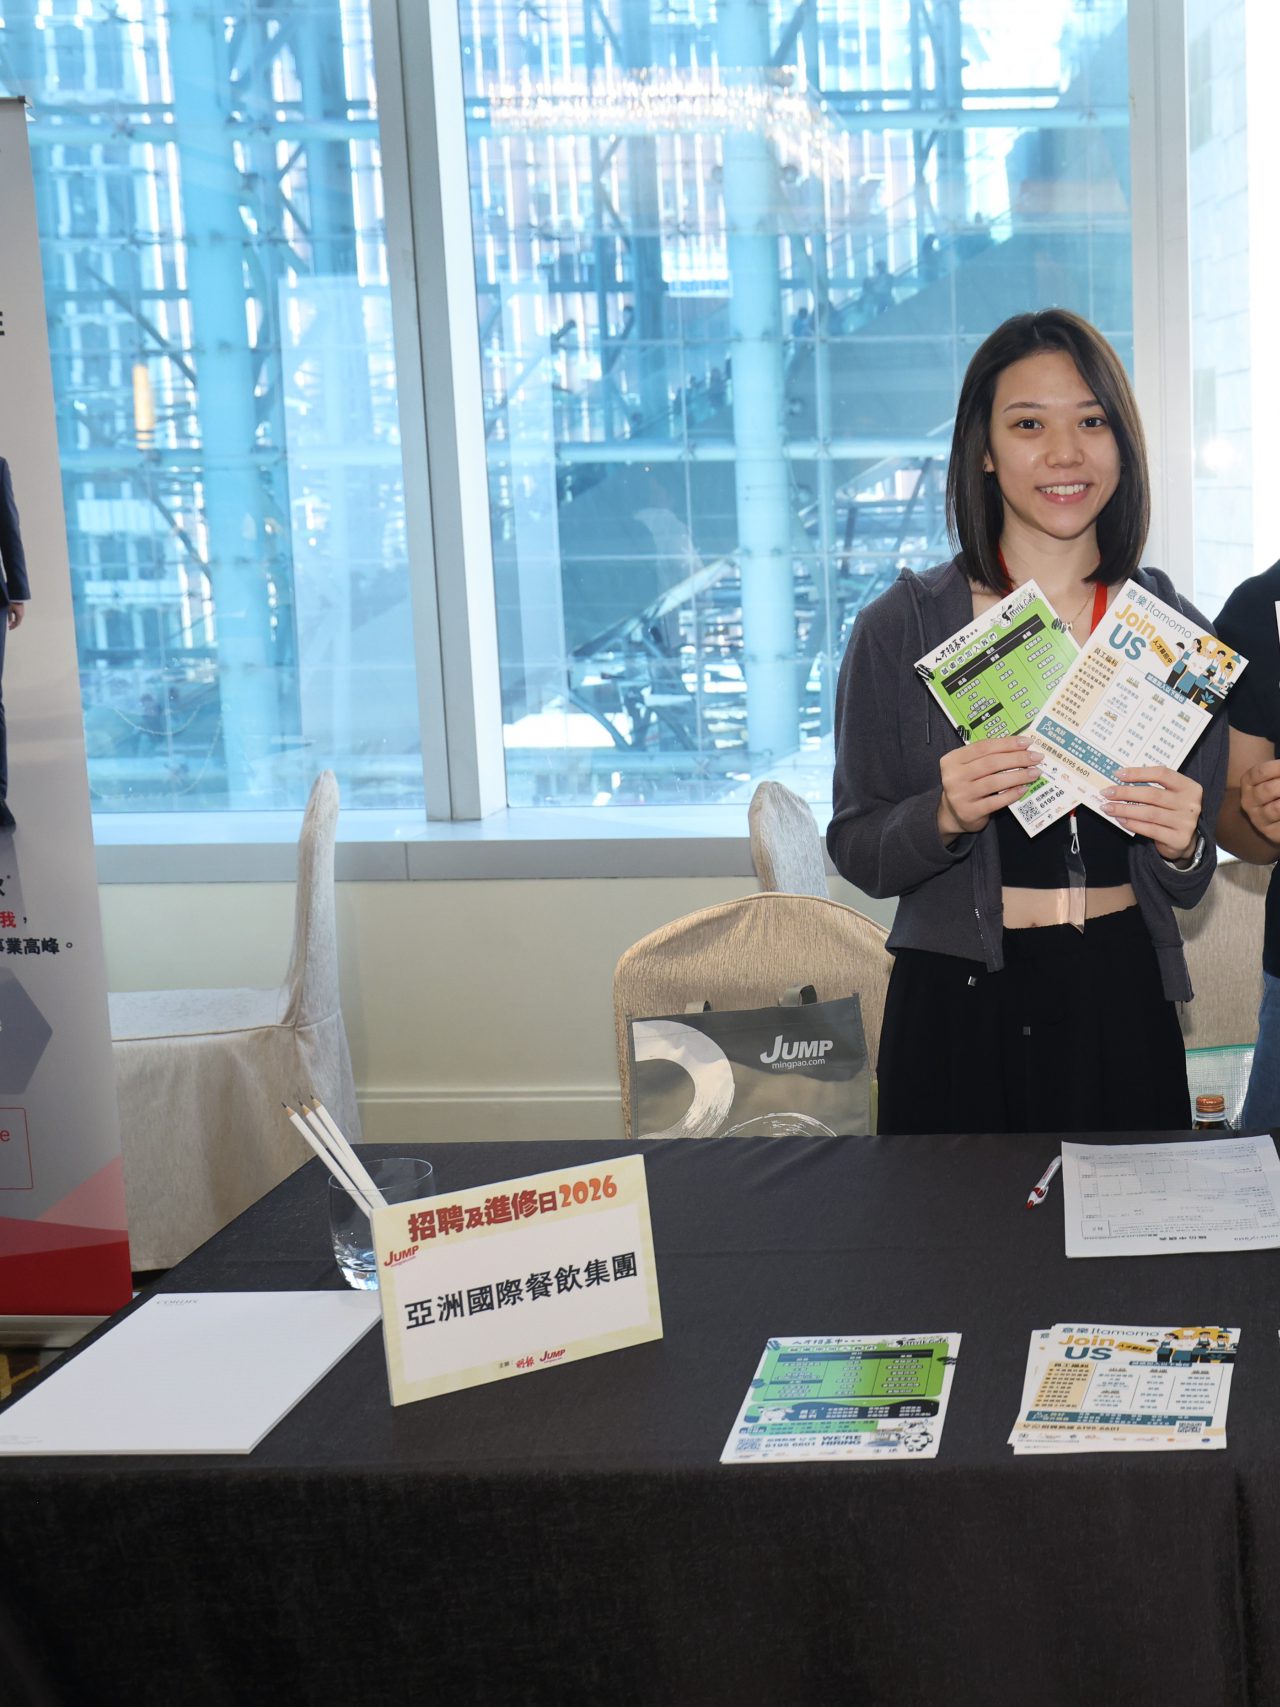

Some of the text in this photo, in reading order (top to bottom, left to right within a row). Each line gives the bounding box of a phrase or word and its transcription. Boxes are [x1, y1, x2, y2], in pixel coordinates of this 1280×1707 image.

[1115, 604, 1156, 639] Join
[1145, 601, 1192, 639] Itamomo
[1109, 624, 1146, 660] US
[1062, 756, 1076, 769] 6195
[1076, 766, 1090, 777] 6601
[1040, 790, 1064, 808] 6195 66
[760, 1035, 833, 1064] JUMP
[771, 1057, 826, 1070] mingpao.com
[407, 1175, 618, 1243] 招聘及進修日2026
[384, 1245, 419, 1267] JUMP
[404, 1251, 638, 1330] 亞洲國際餐飲集團
[1057, 1334, 1116, 1346] Join
[539, 1349, 566, 1362] JUMP
[1062, 1346, 1113, 1360] US
